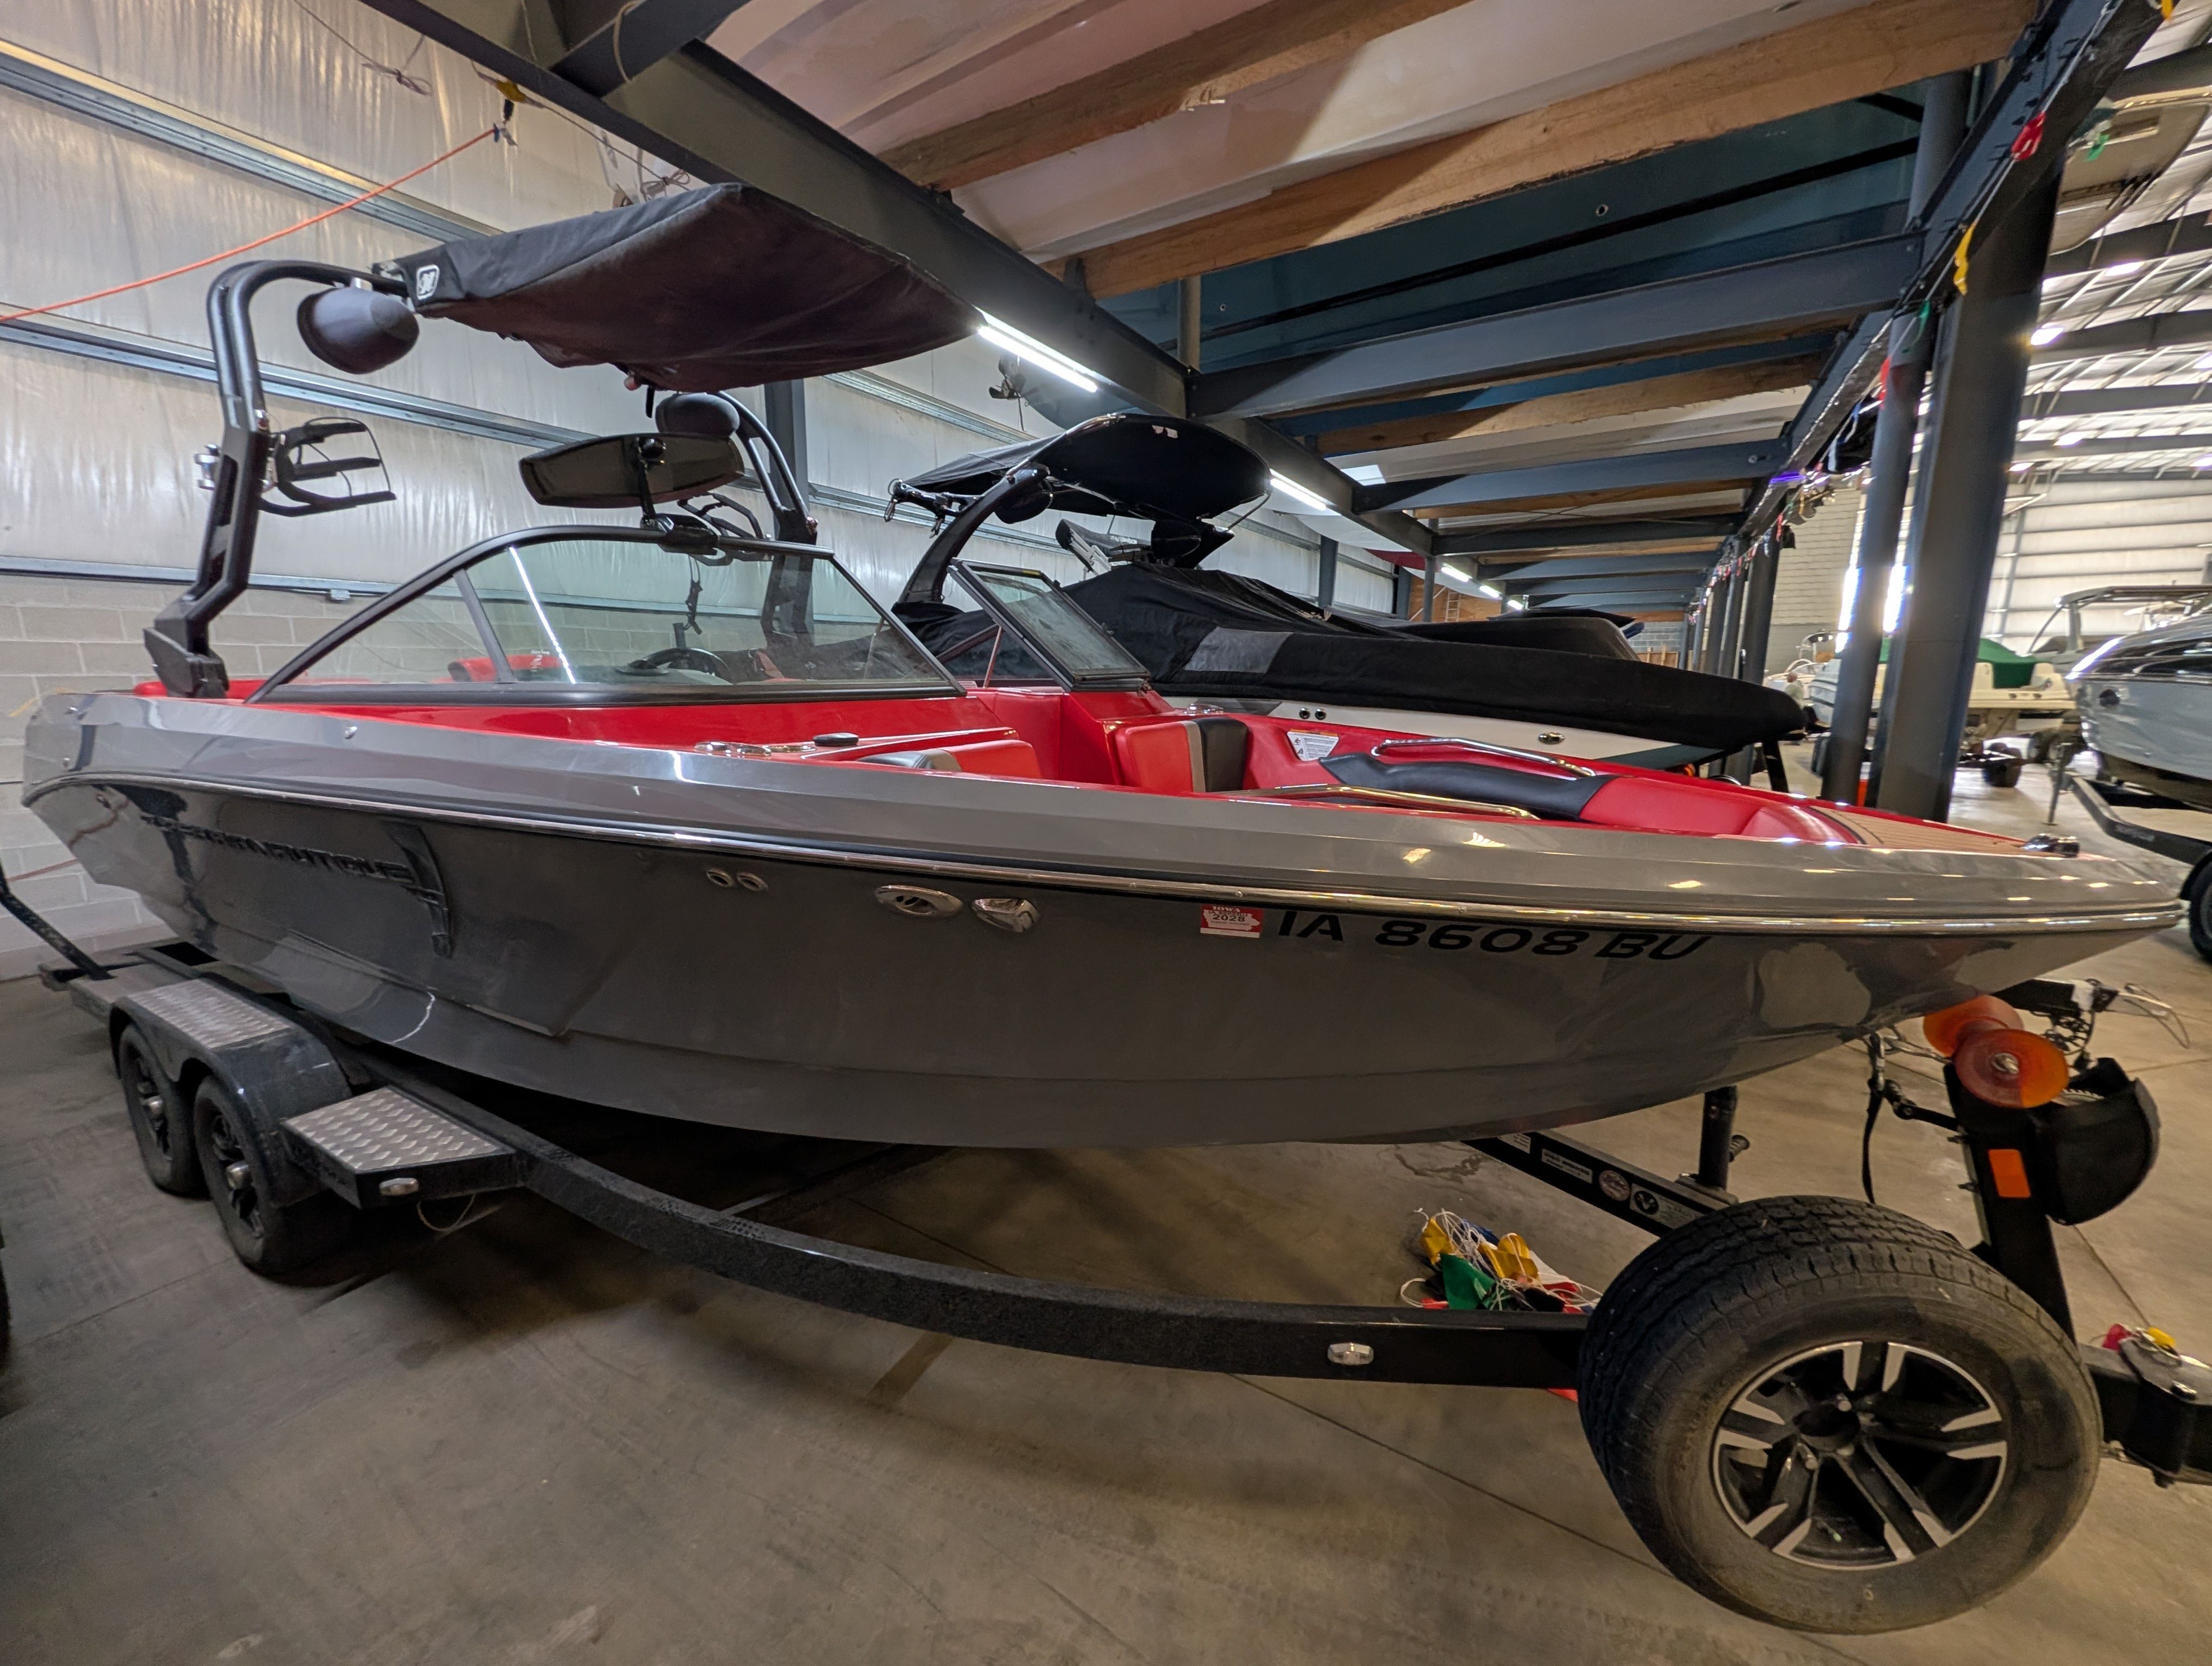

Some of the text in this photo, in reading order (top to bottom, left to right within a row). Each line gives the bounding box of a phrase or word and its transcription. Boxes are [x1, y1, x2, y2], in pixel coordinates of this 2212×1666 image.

[1278, 911, 1713, 959] IA 8608 BU
